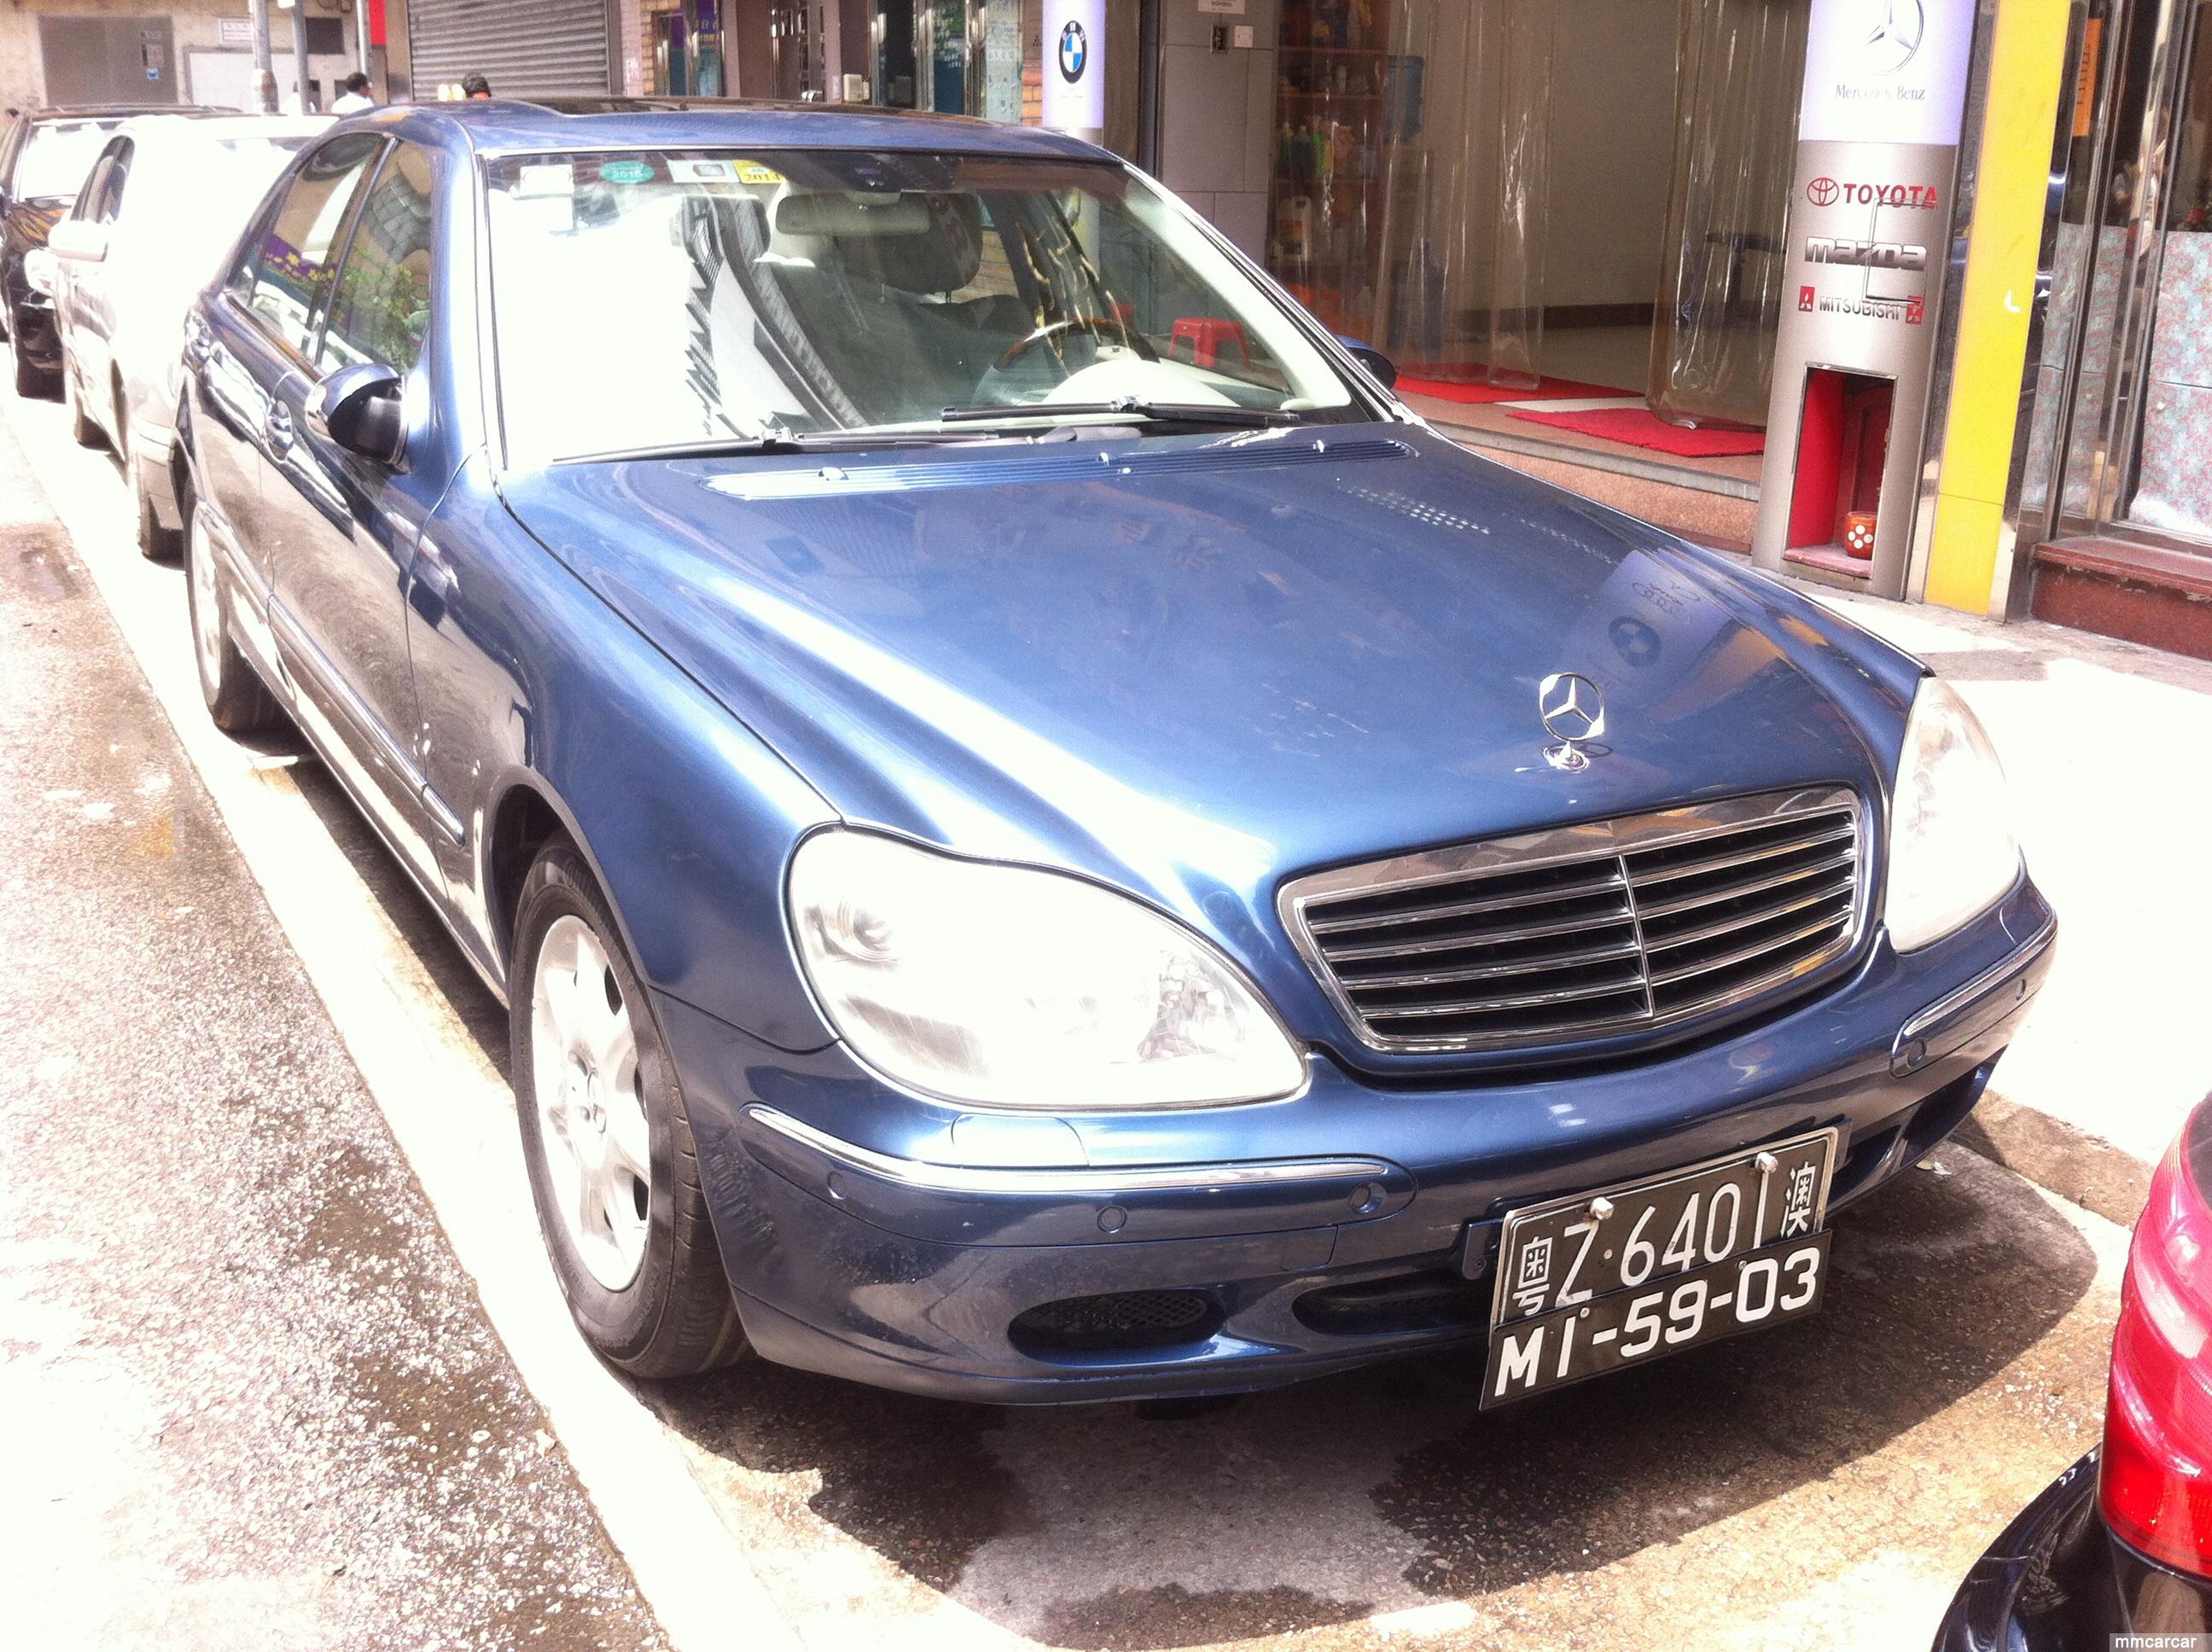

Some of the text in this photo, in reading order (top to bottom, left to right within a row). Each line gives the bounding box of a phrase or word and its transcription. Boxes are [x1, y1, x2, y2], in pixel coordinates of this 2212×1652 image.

[1897, 85, 1926, 101] Benz
[1843, 183, 1939, 210] TOYOTA
[1819, 295, 1901, 321] MITSUBISHI
